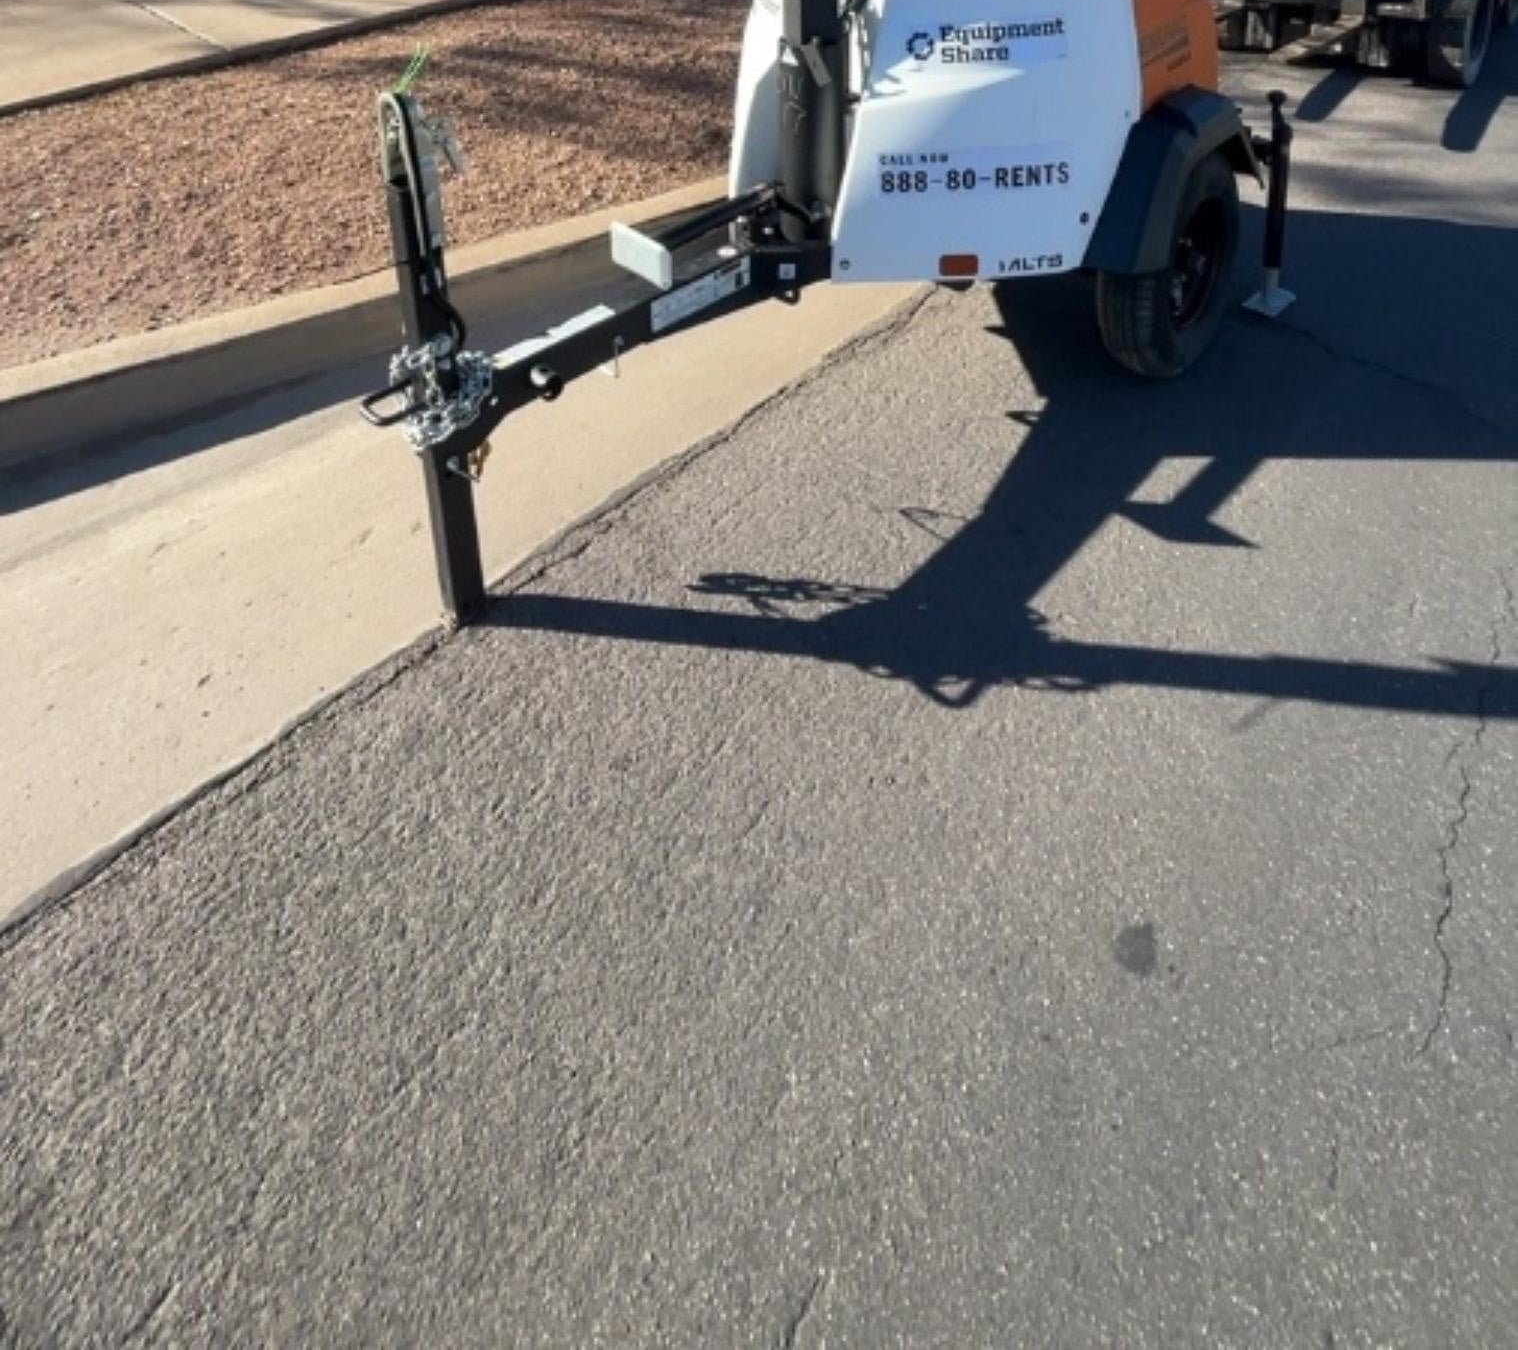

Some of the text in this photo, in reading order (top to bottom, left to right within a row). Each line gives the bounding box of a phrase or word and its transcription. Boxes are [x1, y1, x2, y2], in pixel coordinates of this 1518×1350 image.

[939, 17, 1064, 45] Equipment
[941, 46, 1009, 63] Share
[879, 153, 913, 166] CALL
[881, 161, 1070, 193] 888-80-RENTS
